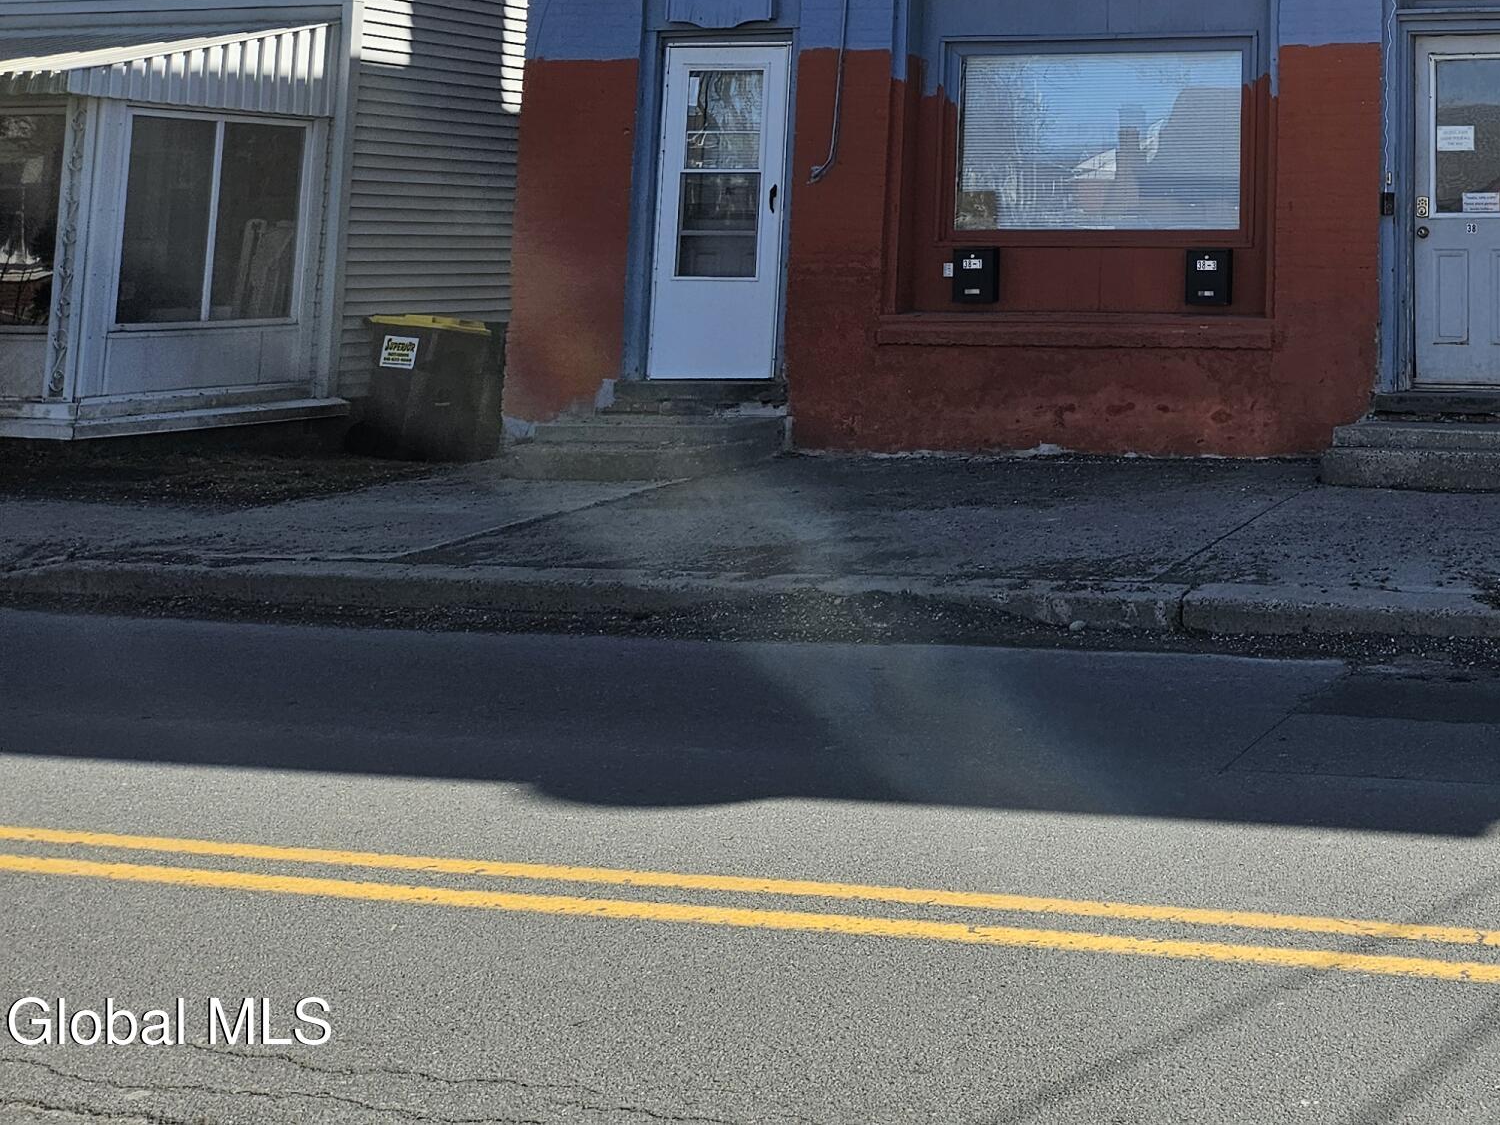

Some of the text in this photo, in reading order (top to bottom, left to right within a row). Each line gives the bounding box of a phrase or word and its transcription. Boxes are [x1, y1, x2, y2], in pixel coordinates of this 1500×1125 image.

[1467, 224, 1477, 233] 38
[963, 260, 981, 268] 38-1
[1197, 261, 1216, 269] 38-3
[385, 338, 415, 352] SUPERIOR
